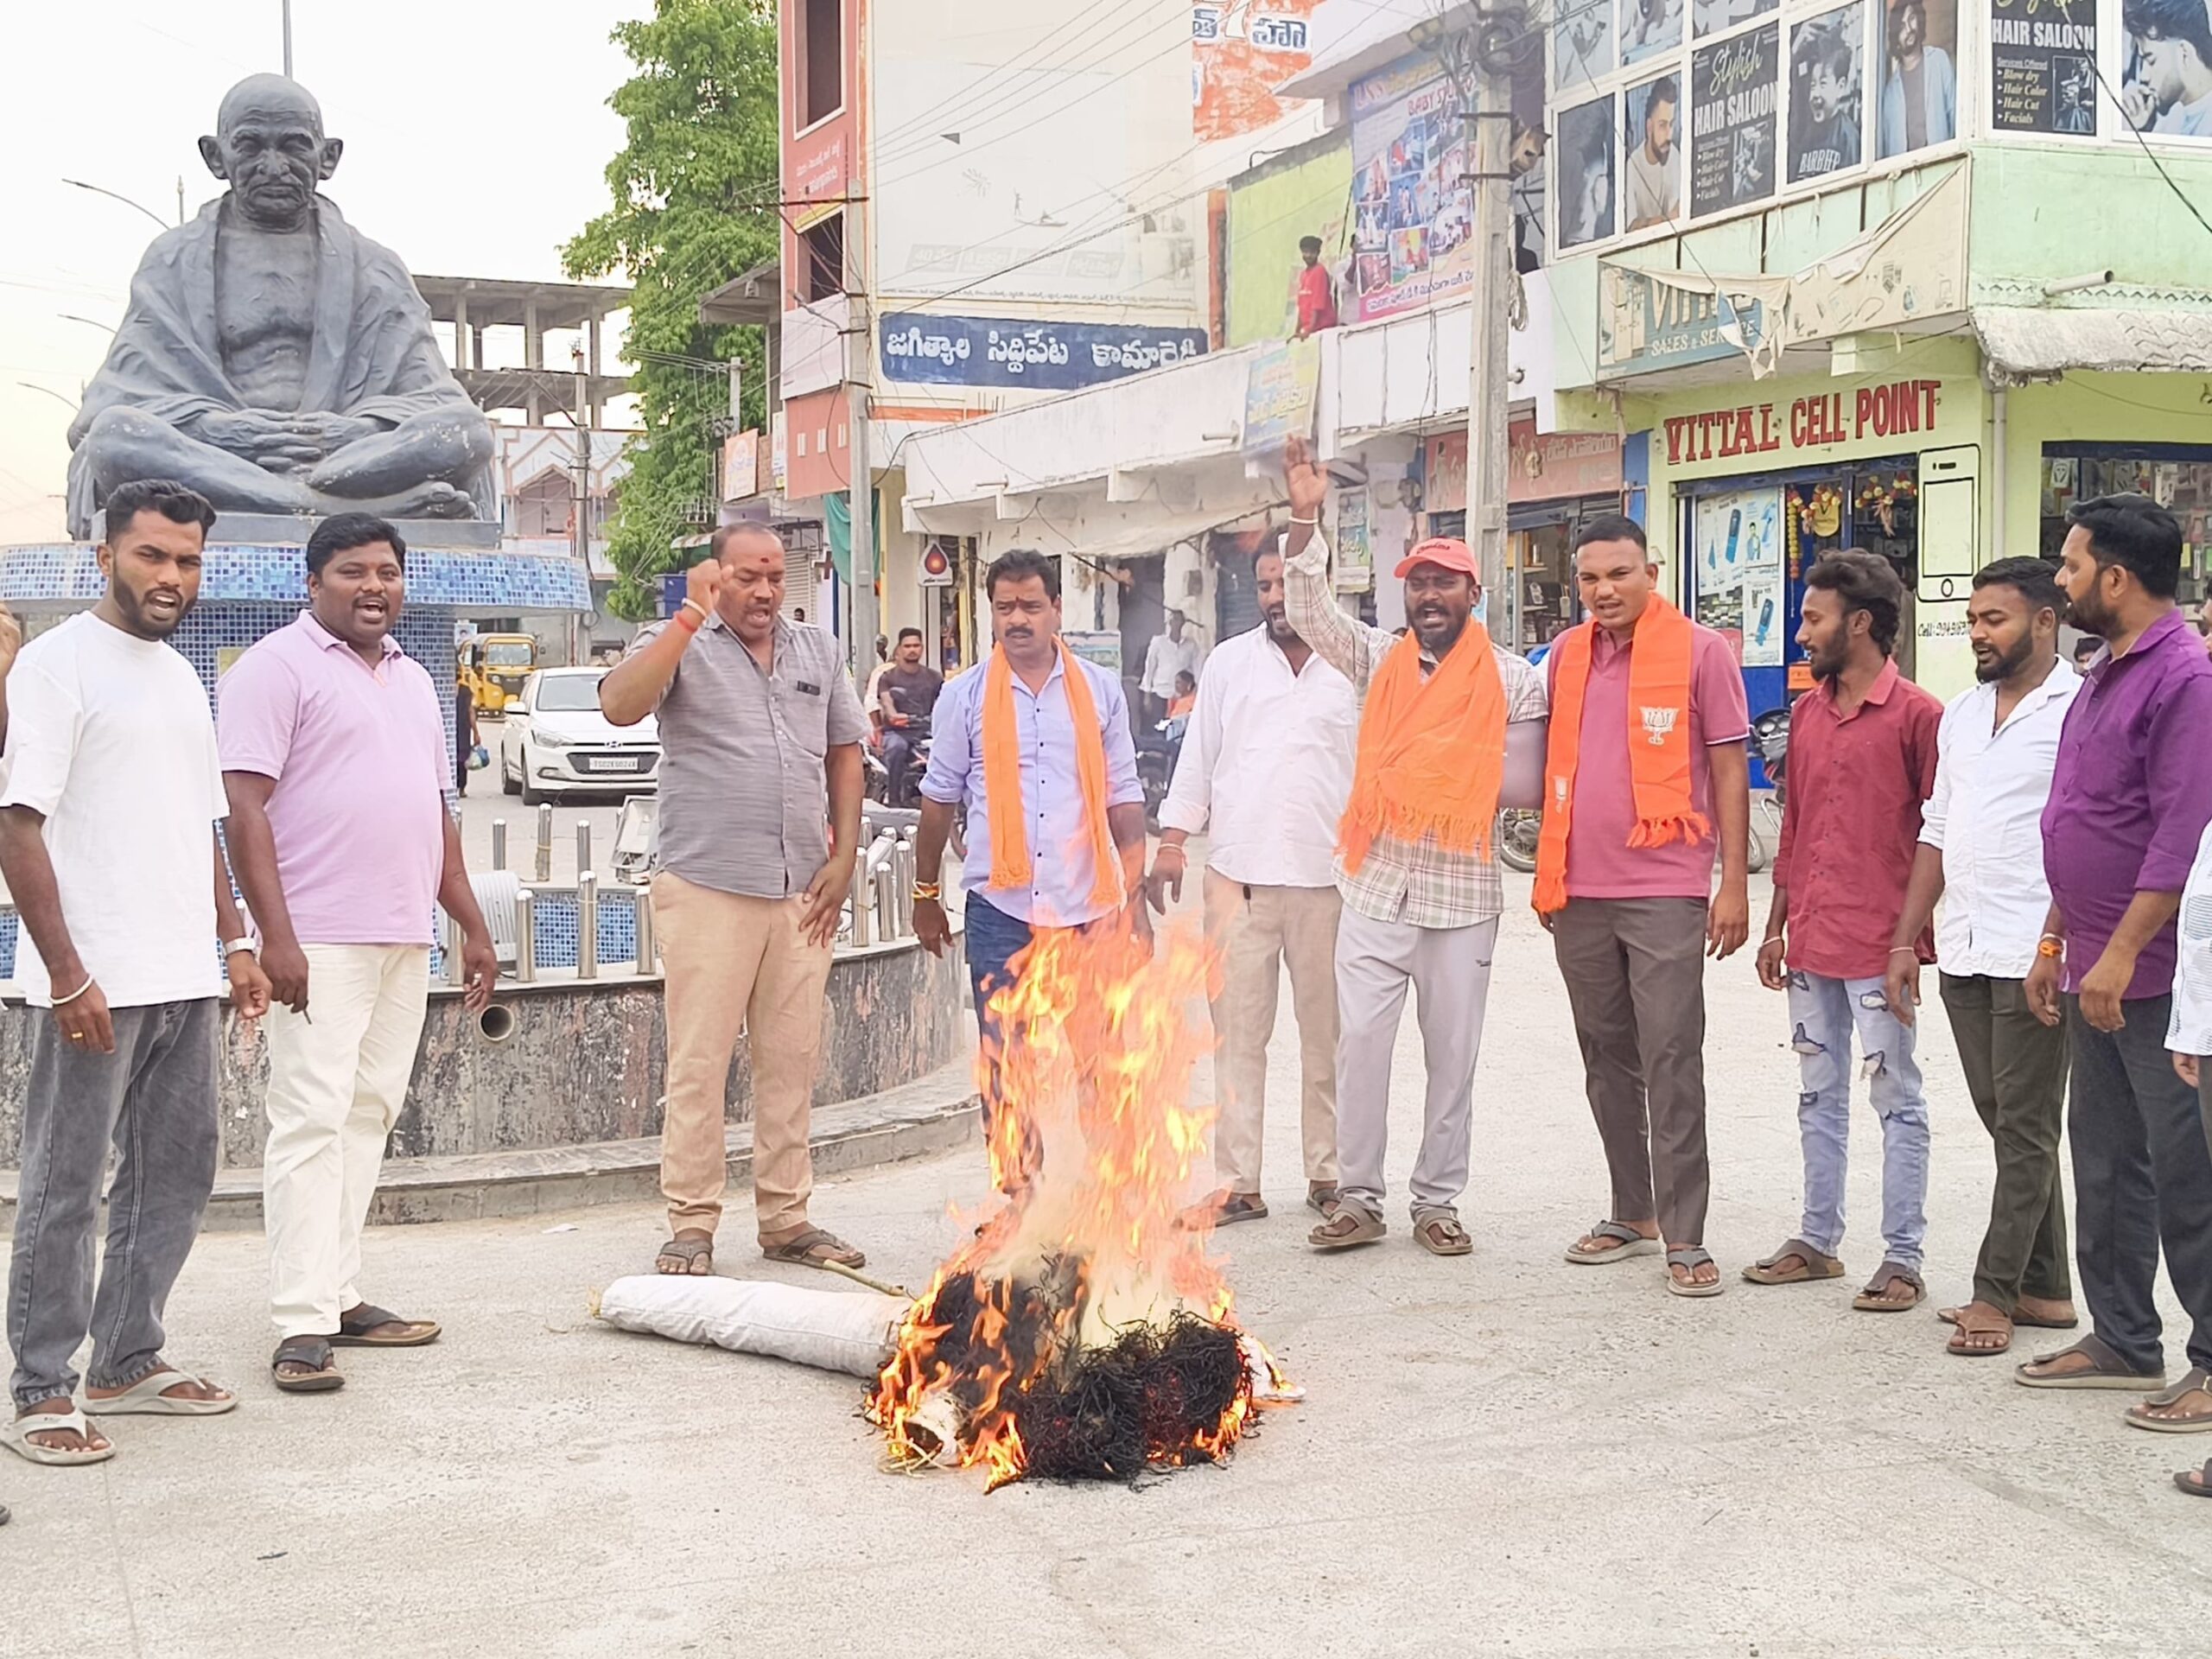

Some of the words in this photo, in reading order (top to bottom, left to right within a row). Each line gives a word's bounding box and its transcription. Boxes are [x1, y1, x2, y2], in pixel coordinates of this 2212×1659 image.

[1992, 18, 2030, 46] HAIR
[2033, 22, 2094, 51] SALOON
[1709, 33, 1763, 96] Stylish
[2025, 70, 2039, 84] dry
[2004, 83, 2023, 94] Hair
[2024, 85, 2048, 96] Color
[2004, 97, 2023, 108] Hair
[2024, 99, 2039, 110] Cut
[1694, 99, 1725, 137] HAIR
[1727, 81, 1778, 127] SALOON
[2004, 111, 2033, 124] Facials
[887, 327, 970, 366] జగిత్యాల
[1651, 334, 1689, 356] SALES
[1700, 320, 1756, 346] SERCE
[1663, 403, 1780, 465] VITTAL
[1790, 391, 1847, 448] CELL
[1855, 379, 1942, 440] POINT
